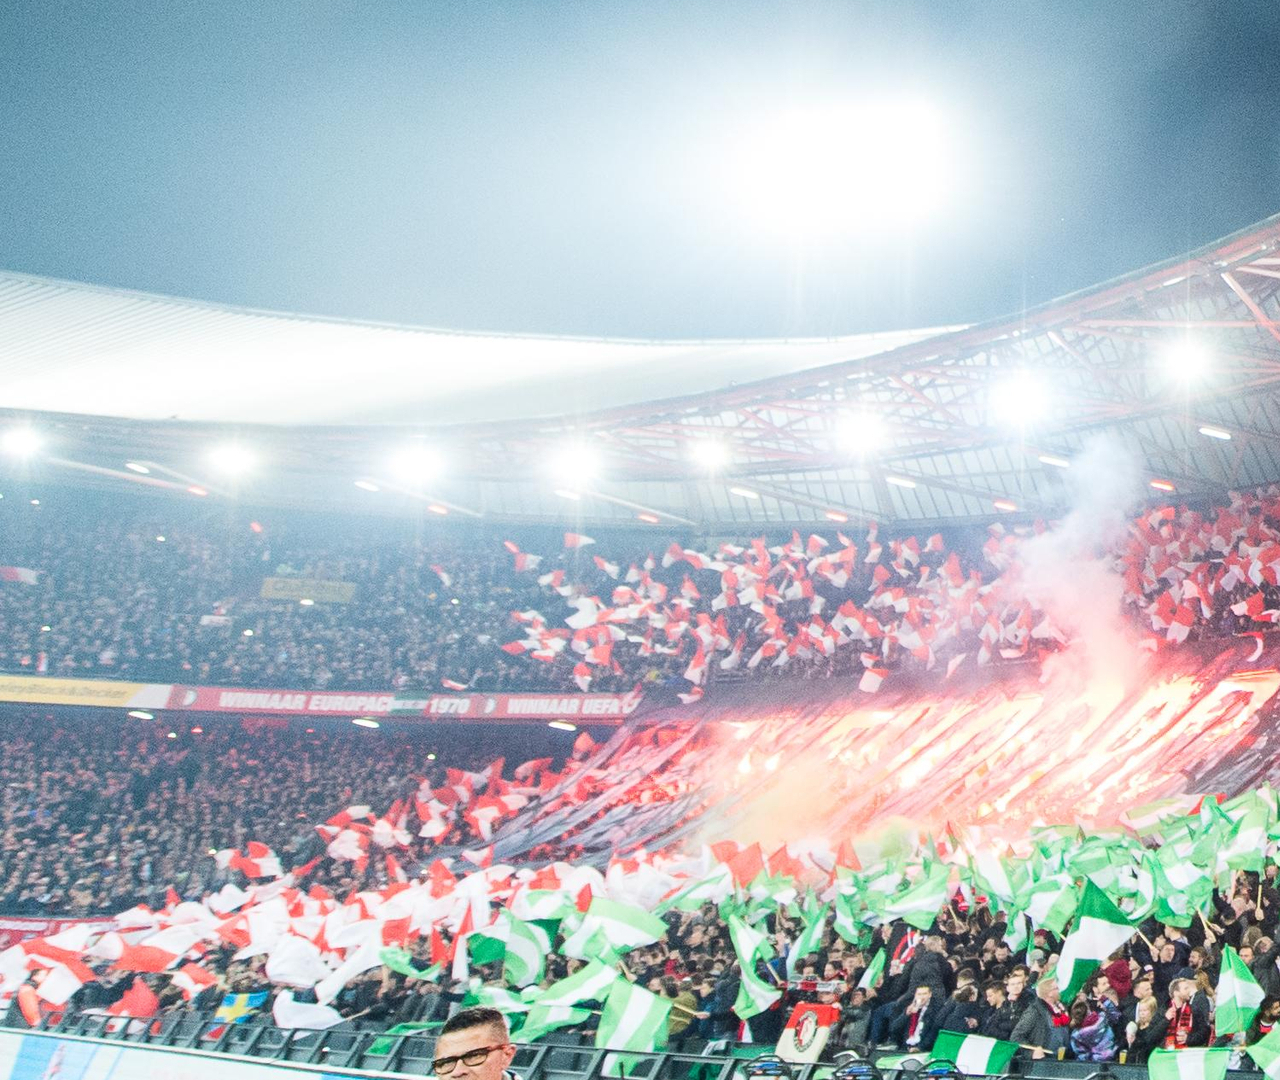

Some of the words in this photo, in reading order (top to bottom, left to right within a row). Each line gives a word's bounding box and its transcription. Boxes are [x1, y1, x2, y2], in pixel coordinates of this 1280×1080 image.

[219, 692, 306, 709] WINNAAR
[429, 698, 470, 714] 1970
[506, 698, 579, 714] WINNAAR
